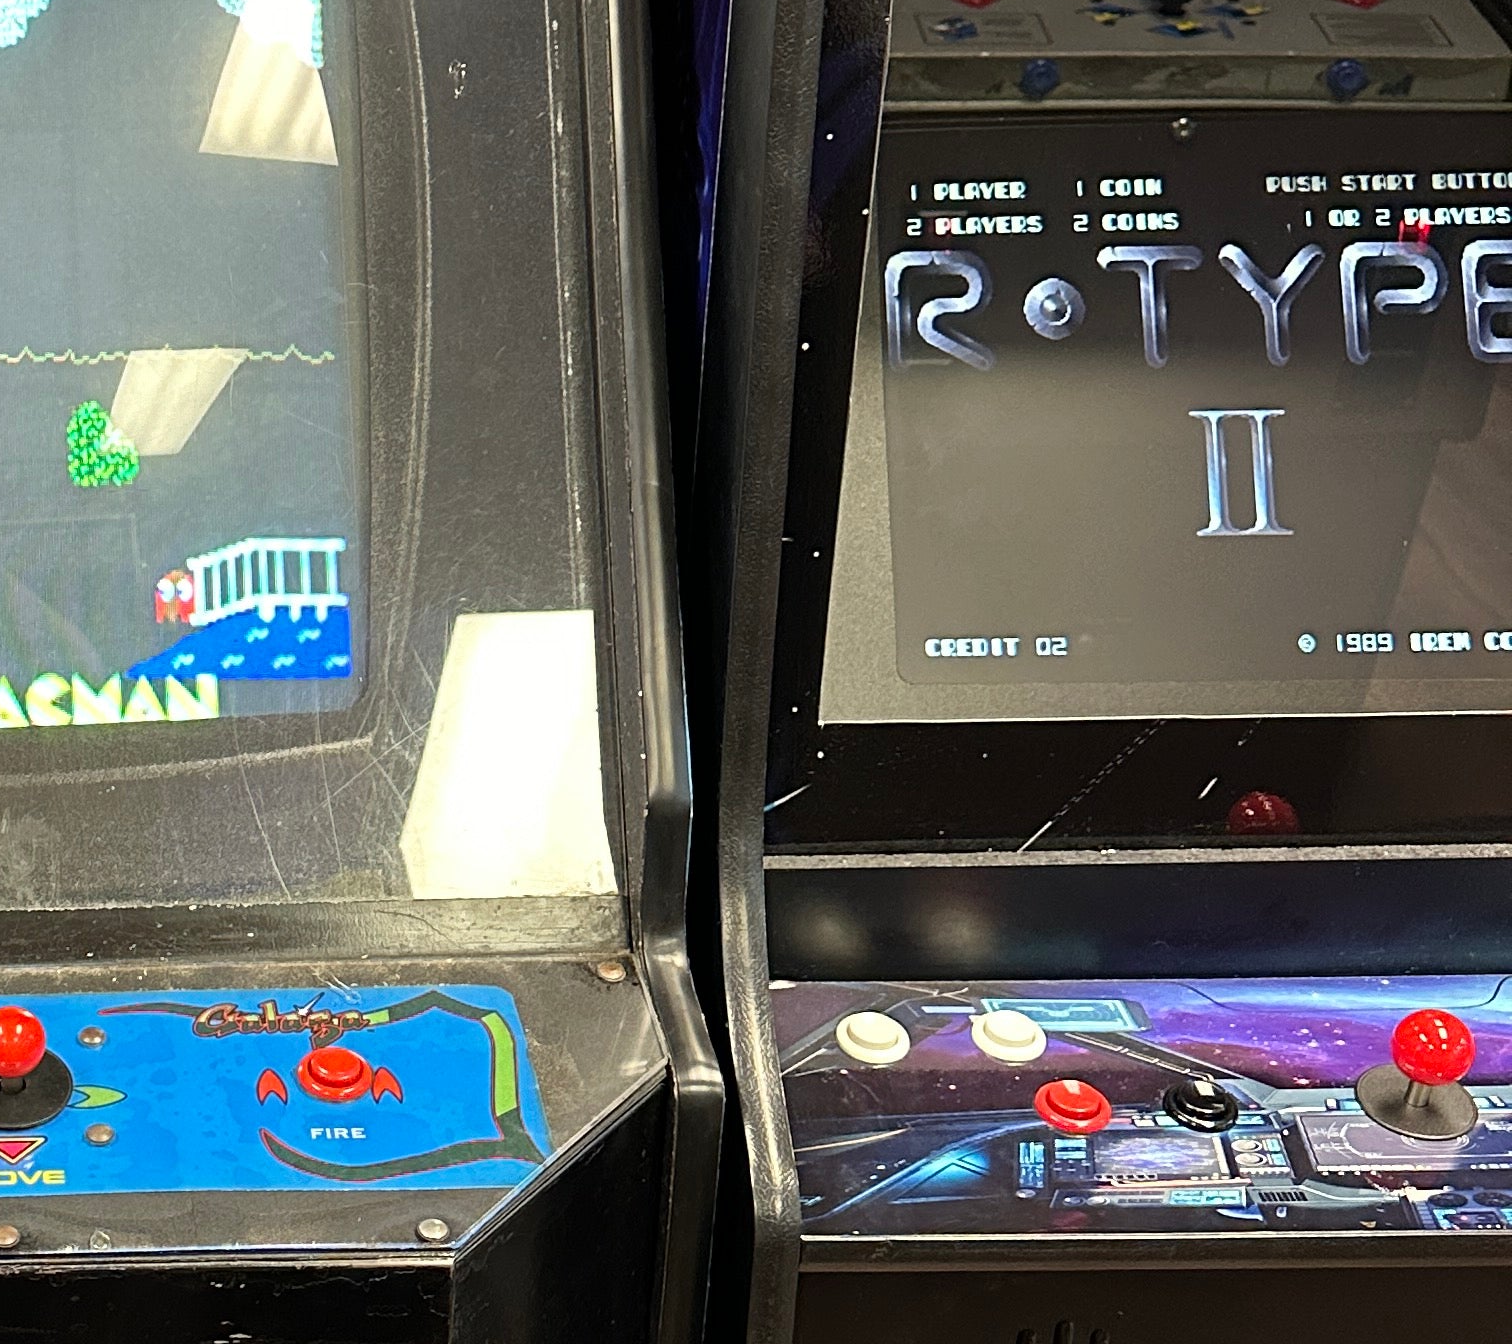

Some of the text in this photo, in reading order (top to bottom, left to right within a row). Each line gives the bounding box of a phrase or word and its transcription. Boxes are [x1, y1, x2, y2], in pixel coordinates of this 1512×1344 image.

[910, 178, 1163, 201] 1 PLAYER 1 COIN
[1265, 171, 1512, 193] PUSH START BUTTO
[906, 212, 1180, 236] 2 PLAYERS 2 COINS
[1305, 206, 1512, 228] 1 OR 2 PLAYERS
[924, 637, 1068, 658] CREDIT 02
[1336, 632, 1394, 653] 1989
[1409, 631, 1472, 653] IREM
[193, 999, 371, 1050] Galaga
[310, 1126, 367, 1140] FIRE
